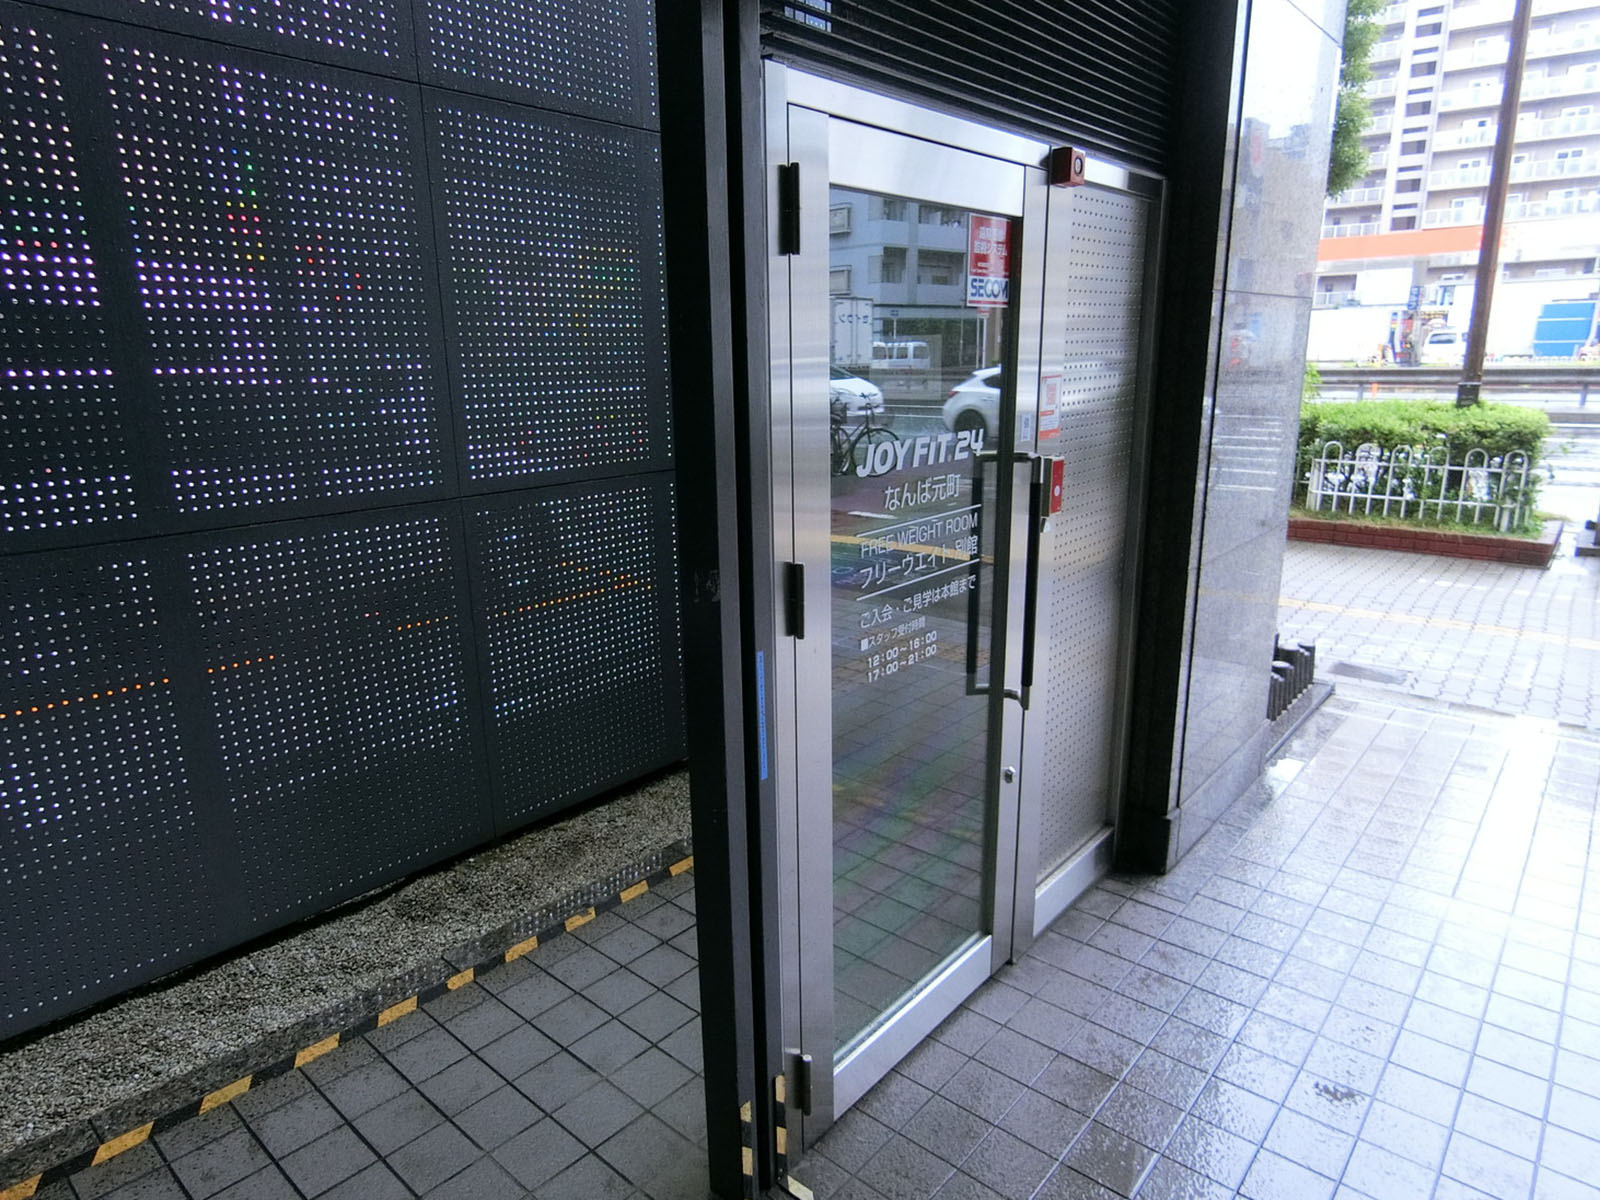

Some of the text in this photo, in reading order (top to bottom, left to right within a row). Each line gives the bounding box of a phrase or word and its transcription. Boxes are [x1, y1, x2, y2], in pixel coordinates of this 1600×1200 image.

[970, 278, 1008, 299] SECOM
[885, 474, 961, 511] なんば元町
[860, 512, 978, 559] FREE WEIGHT ROOM
